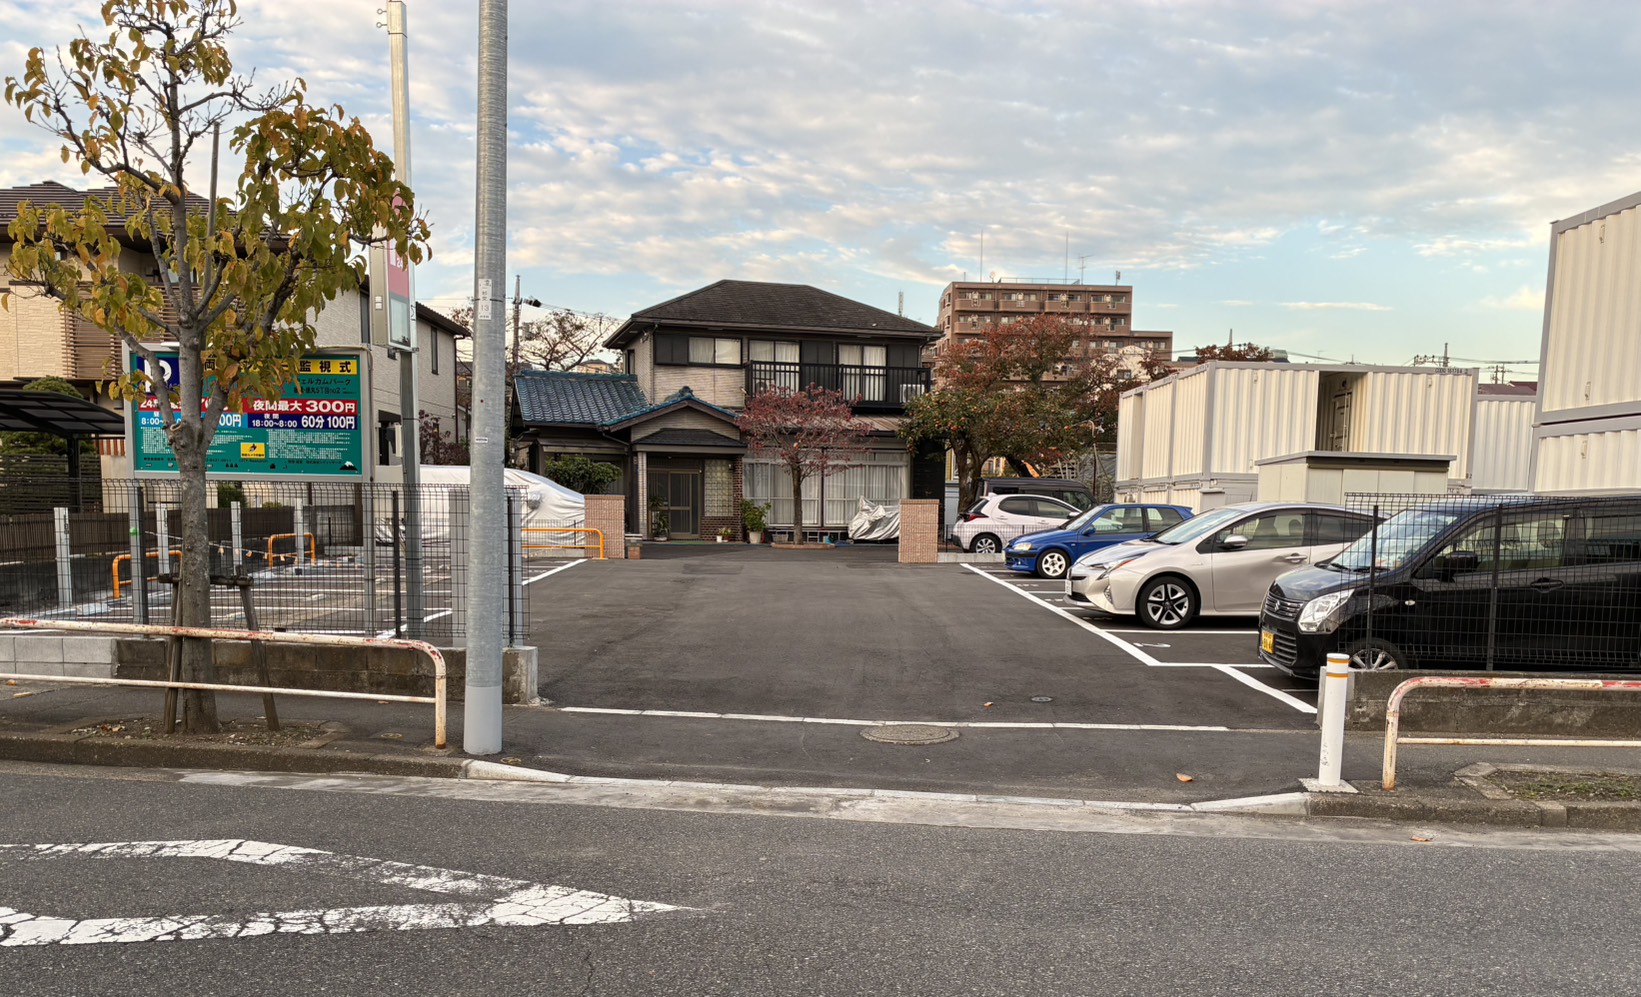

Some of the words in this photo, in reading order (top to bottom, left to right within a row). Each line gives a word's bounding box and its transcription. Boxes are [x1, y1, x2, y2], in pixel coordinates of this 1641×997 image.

[296, 377, 351, 386] ェルカムパーク
[253, 400, 303, 412] 夜間最大
[305, 400, 355, 413] 300円
[301, 415, 325, 429] 60分
[327, 415, 355, 430] 100円
